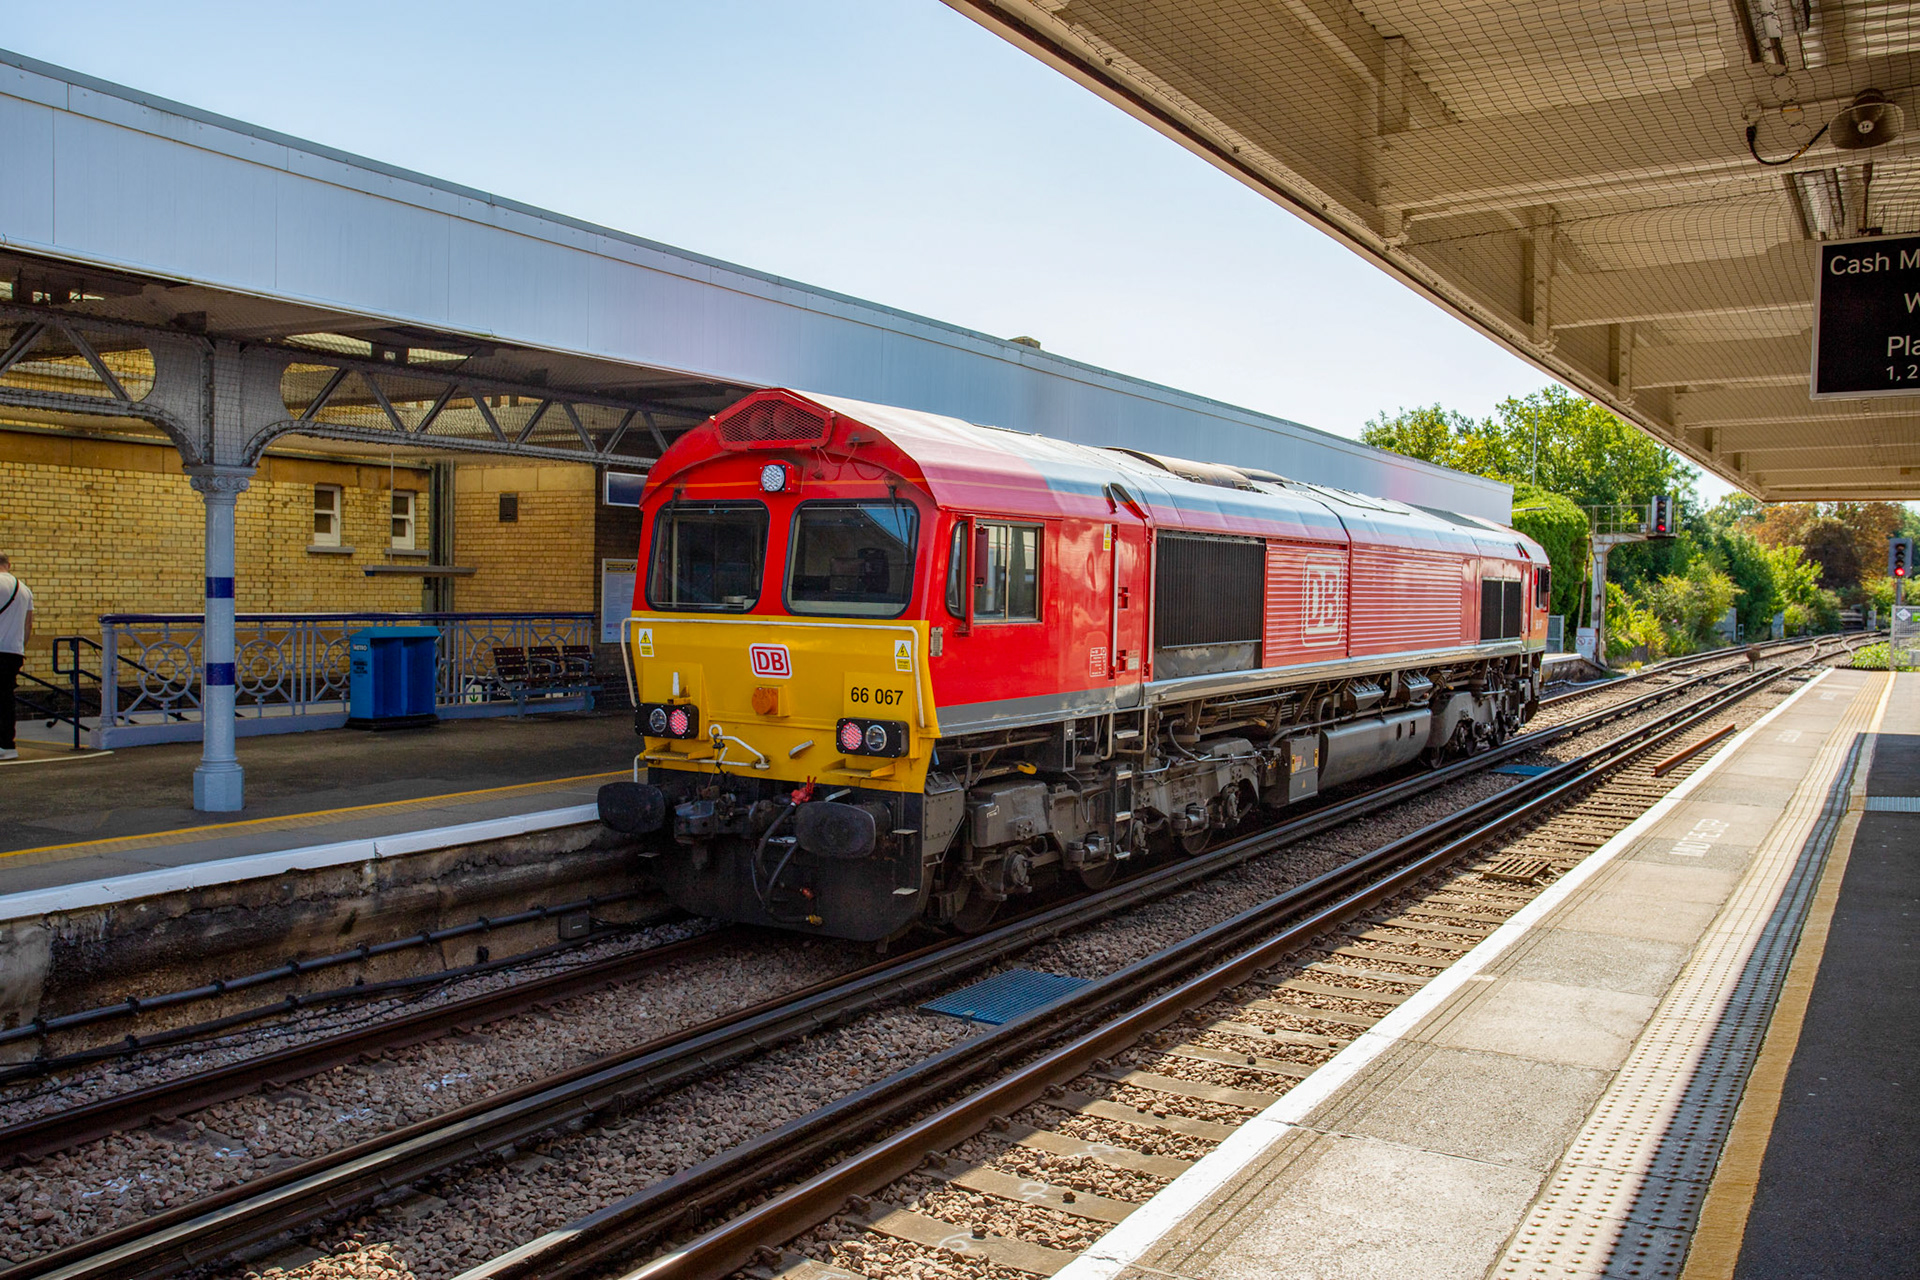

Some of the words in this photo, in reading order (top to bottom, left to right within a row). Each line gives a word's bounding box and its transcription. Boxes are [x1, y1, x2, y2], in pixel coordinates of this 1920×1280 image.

[1830, 252, 1890, 275] Cash
[1887, 335, 1920, 357] Pla
[1886, 365, 1901, 382] 1,
[1907, 364, 1918, 379] 2
[1308, 570, 1338, 628] DB
[756, 651, 784, 671] DB
[851, 686, 869, 703] 66
[875, 688, 903, 705] 067
